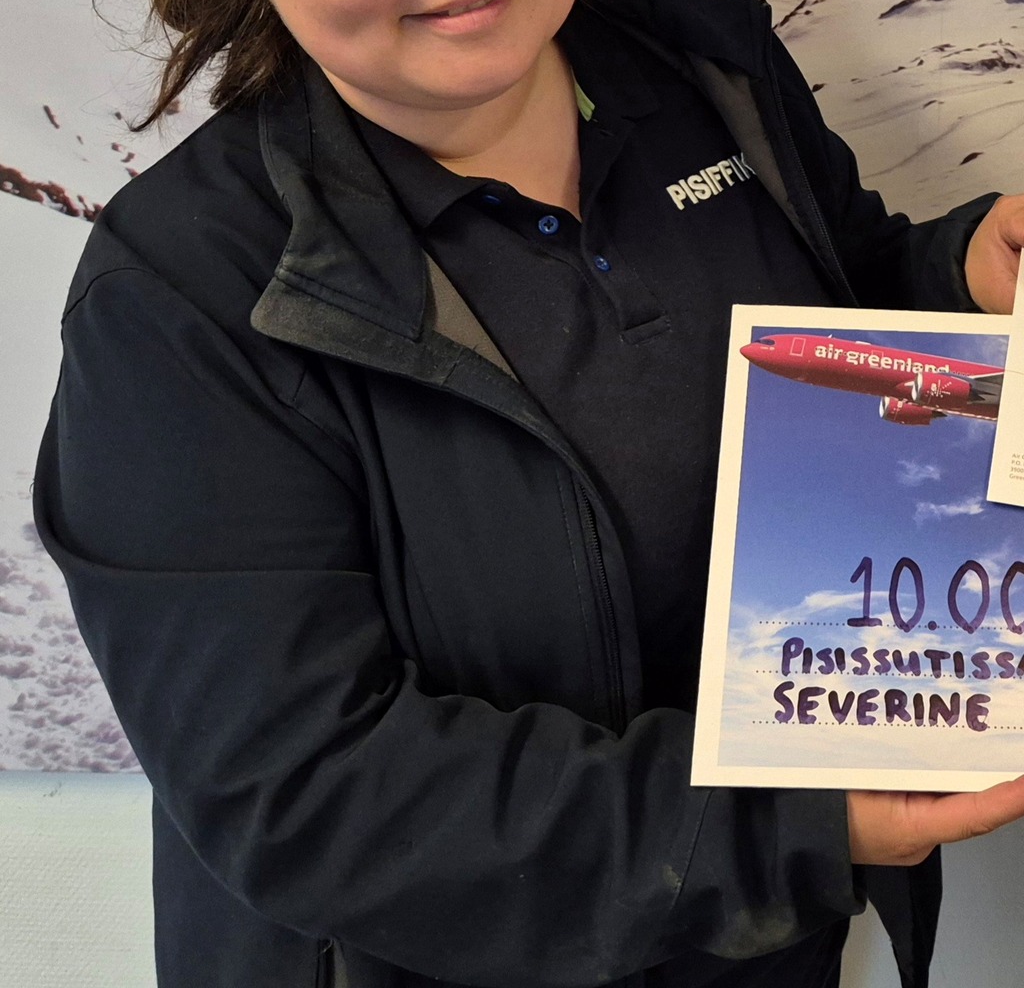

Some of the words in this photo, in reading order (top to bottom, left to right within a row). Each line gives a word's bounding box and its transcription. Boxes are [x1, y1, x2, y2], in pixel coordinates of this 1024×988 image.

[666, 153, 756, 210] PISIFFIK
[814, 344, 843, 360] air
[846, 350, 950, 375] greenland
[773, 680, 991, 732] SEVERINE
